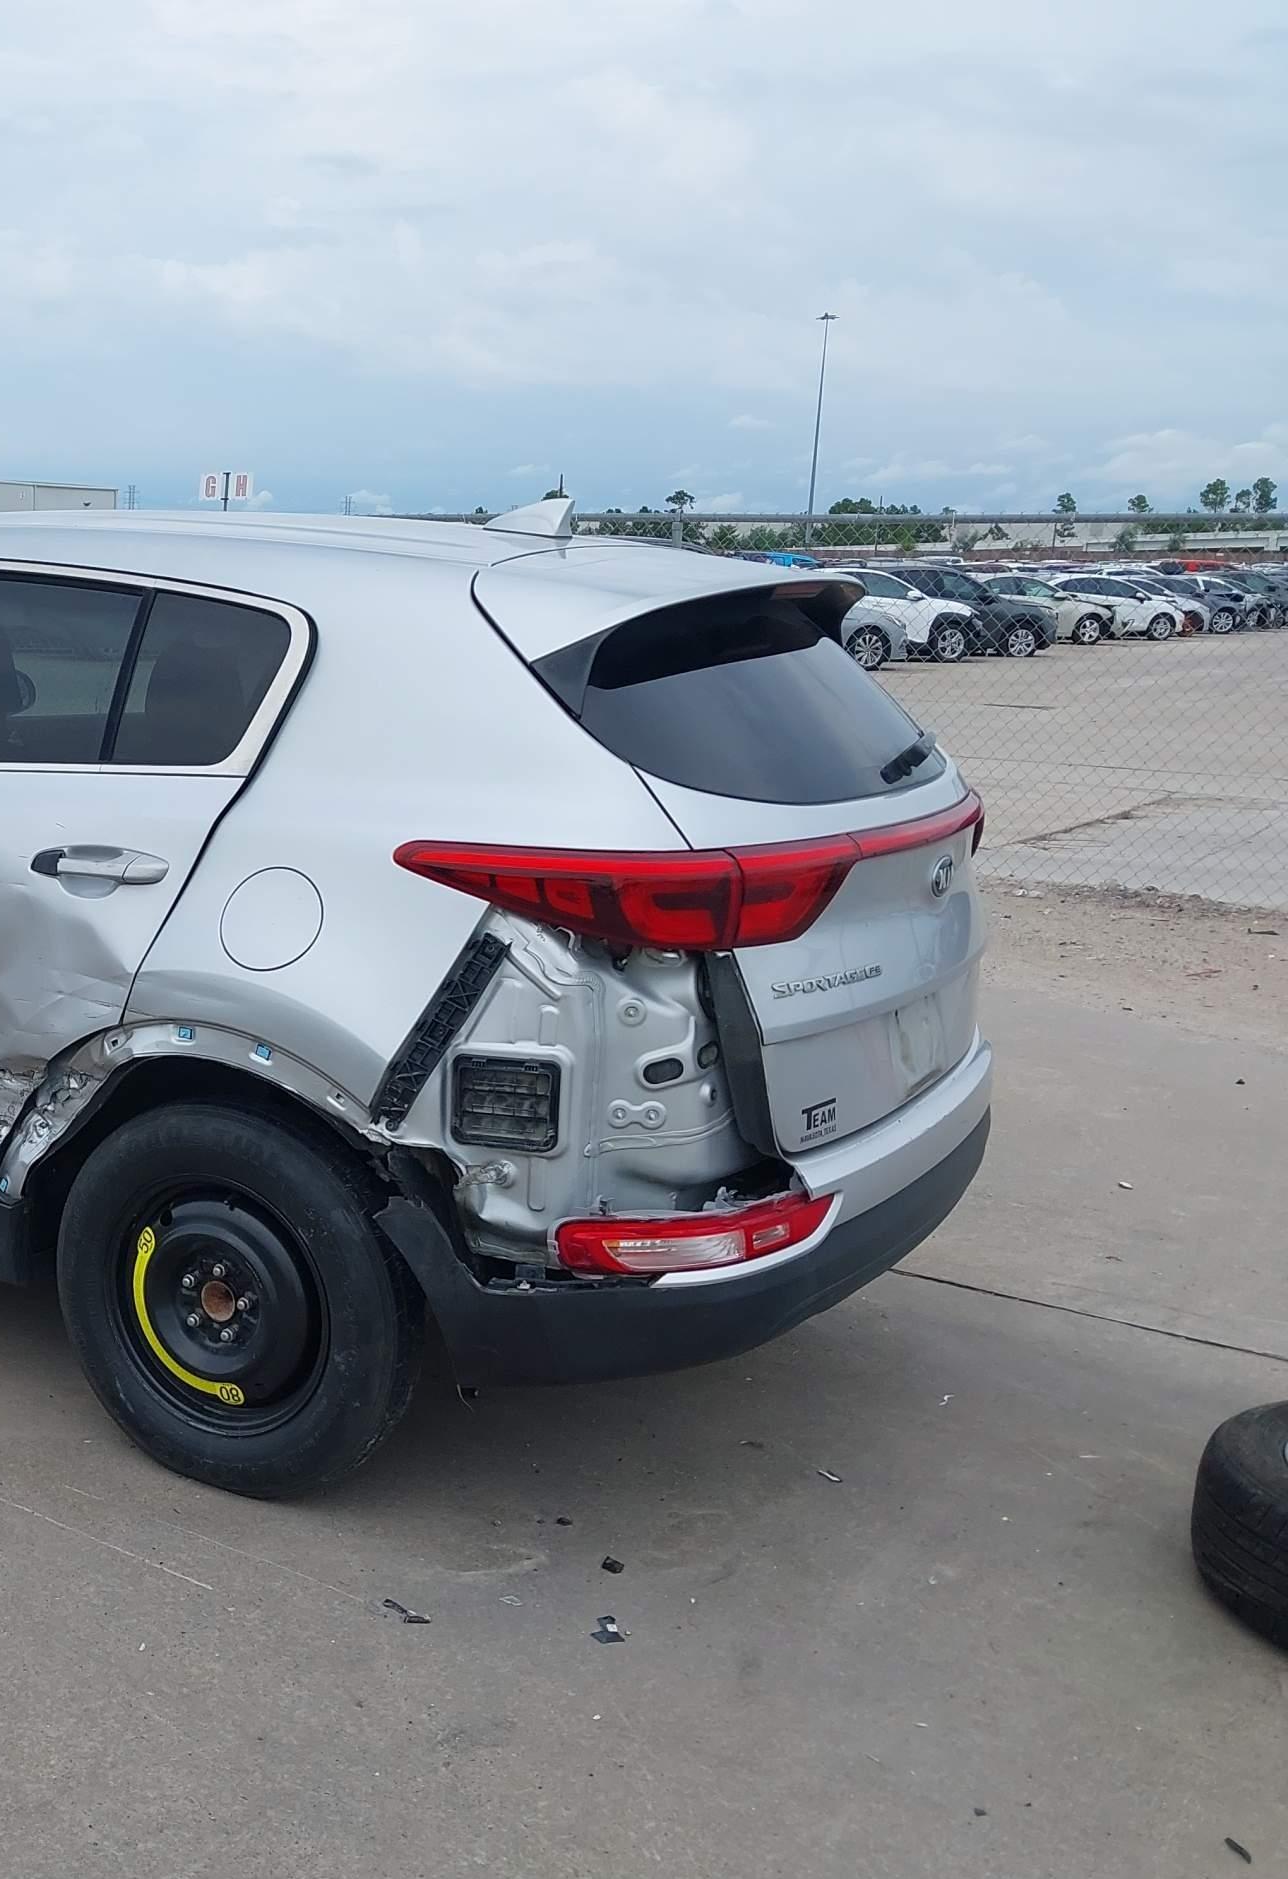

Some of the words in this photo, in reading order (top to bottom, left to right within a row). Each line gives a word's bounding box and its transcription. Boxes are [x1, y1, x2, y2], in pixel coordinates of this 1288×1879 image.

[204, 475, 217, 498] G
[235, 474, 248, 497] H
[801, 1097, 837, 1131] TEAM
[139, 1230, 153, 1254] 50
